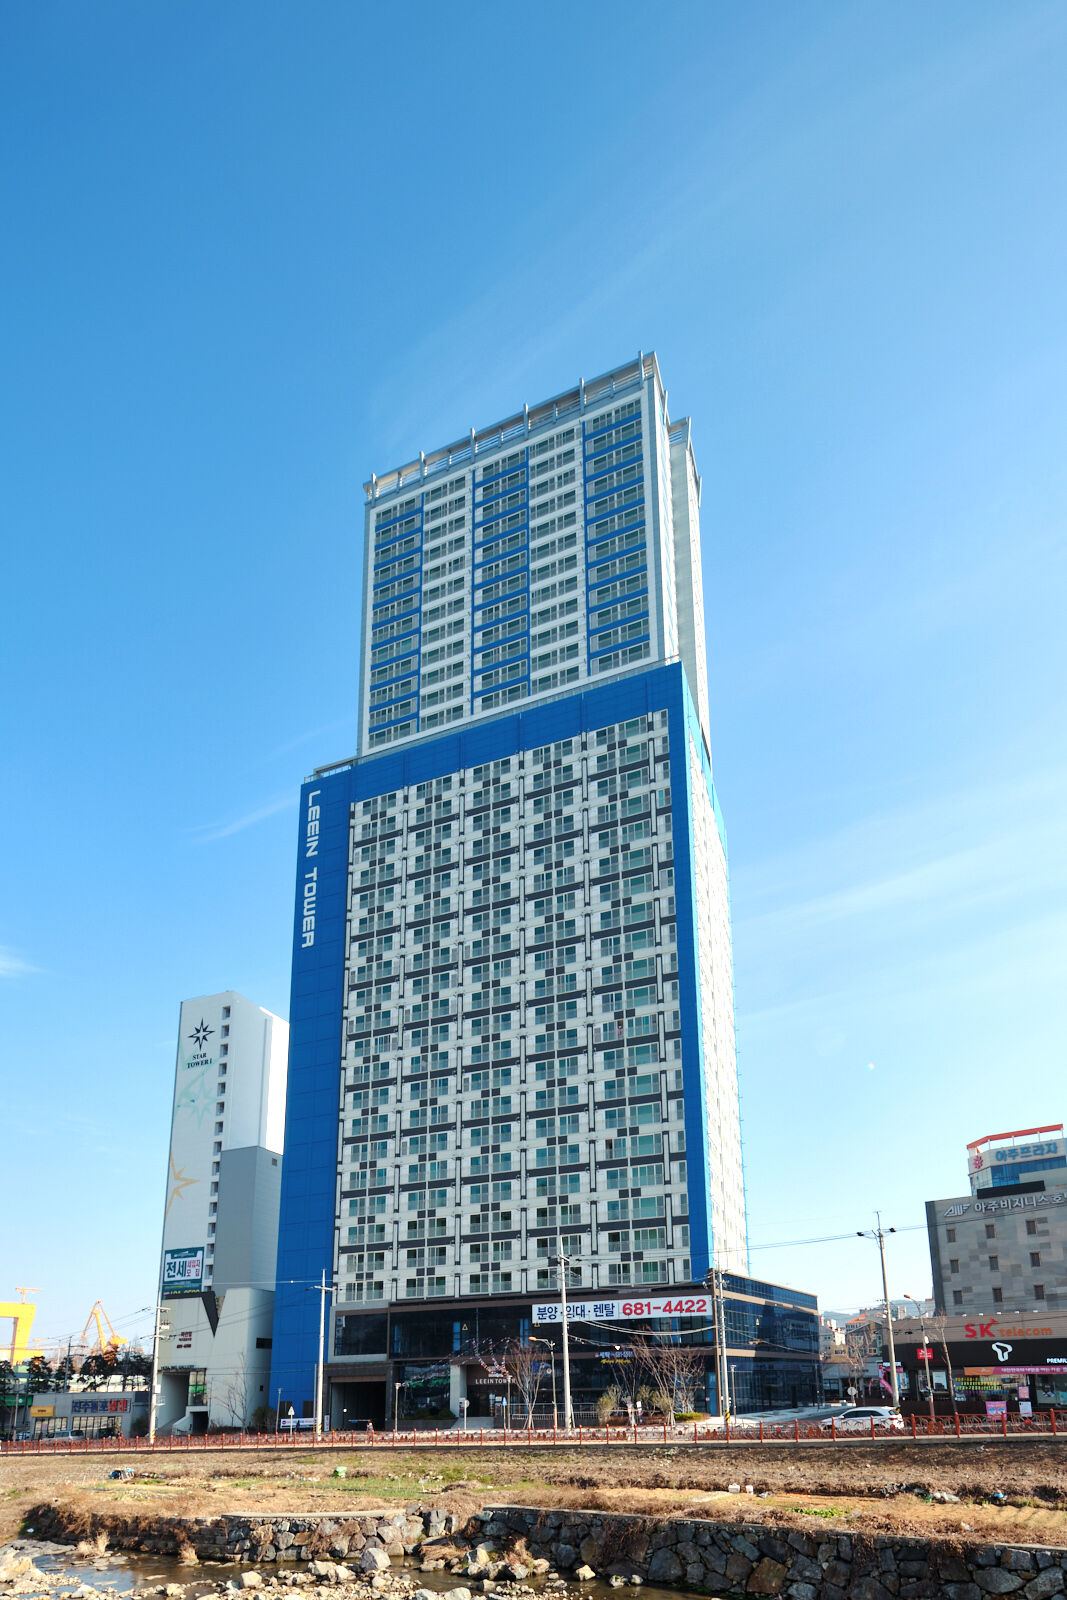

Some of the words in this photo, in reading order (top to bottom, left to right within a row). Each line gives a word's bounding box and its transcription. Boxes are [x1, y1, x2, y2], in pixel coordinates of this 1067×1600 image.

[306, 790, 321, 858] LEEIN
[302, 867, 317, 949] TOWER
[187, 1059, 209, 1069] TOWER
[975, 1192, 1067, 1213] 아주비지니스호
[166, 1260, 187, 1278] 전세
[622, 1299, 707, 1317] 681-4422
[965, 1323, 995, 1338] SK
[1000, 1326, 1053, 1337] telecom
